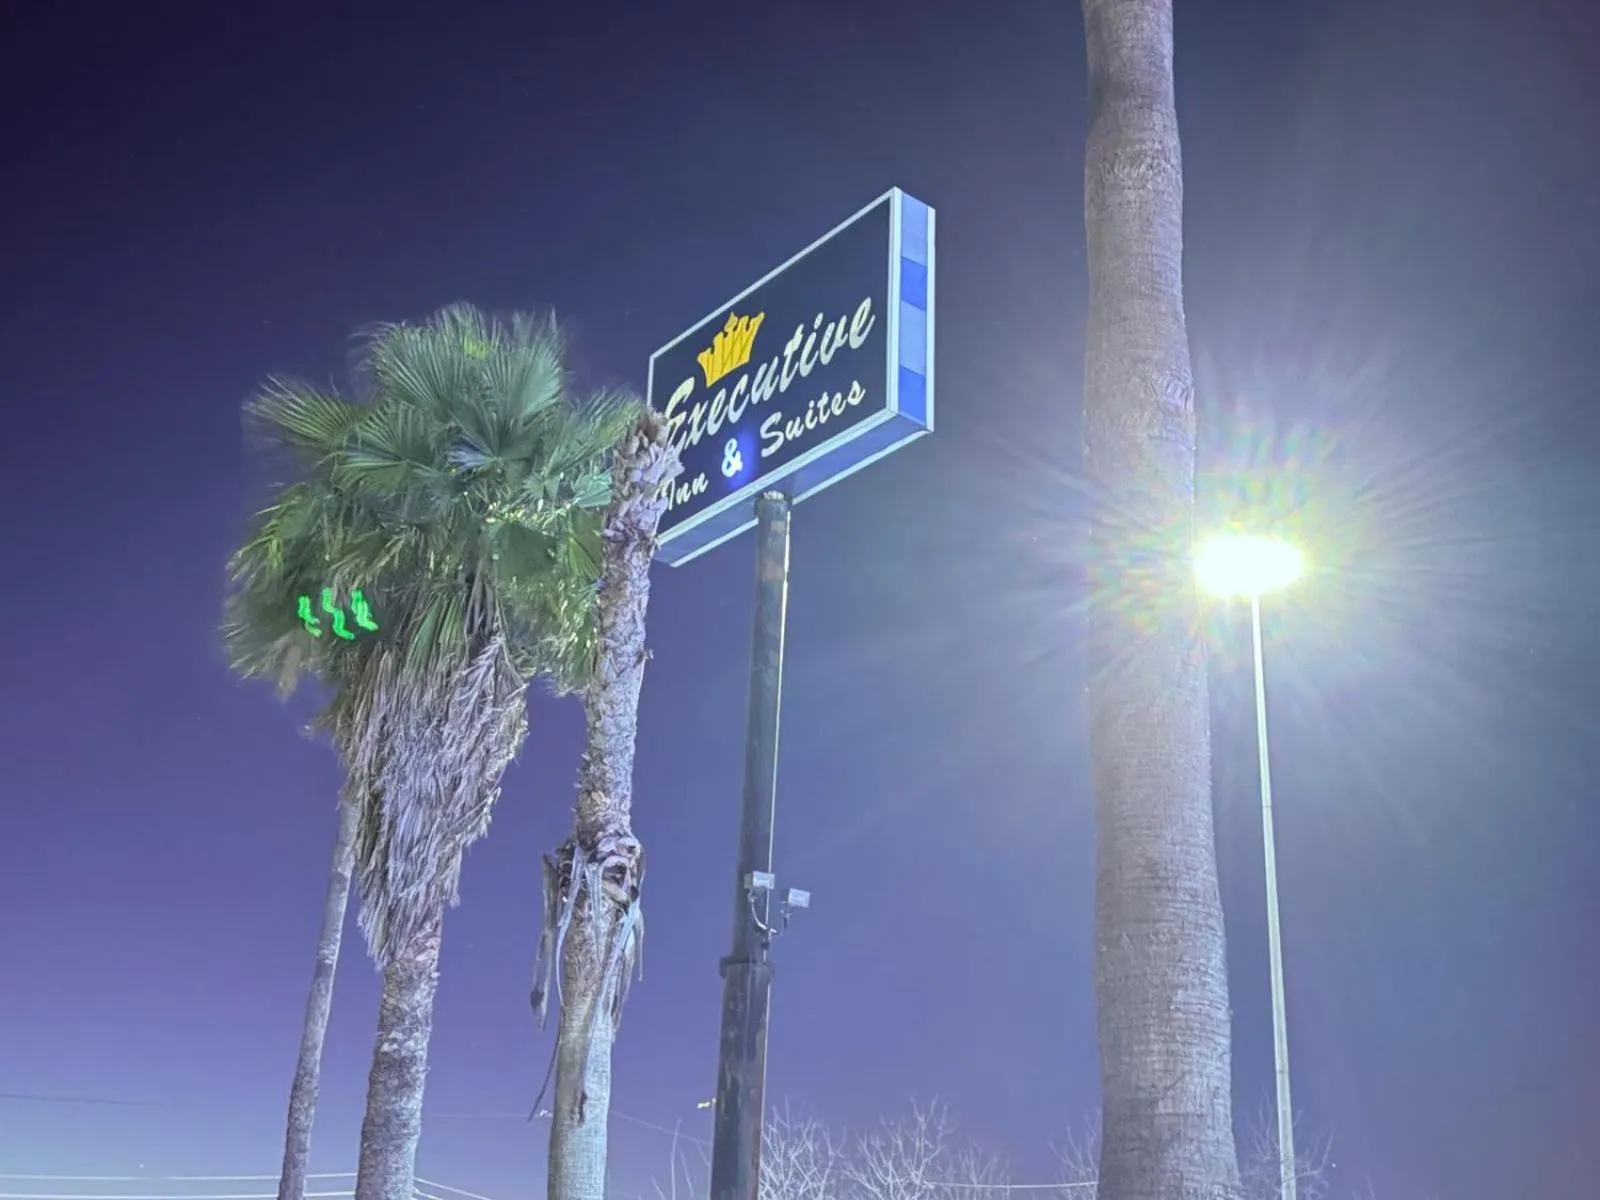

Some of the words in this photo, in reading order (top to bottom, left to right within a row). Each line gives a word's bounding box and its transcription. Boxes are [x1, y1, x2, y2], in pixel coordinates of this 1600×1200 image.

[654, 472, 709, 511] Inn
[721, 438, 743, 478] &
[760, 380, 866, 458] Suites
[664, 297, 876, 454] Executive
